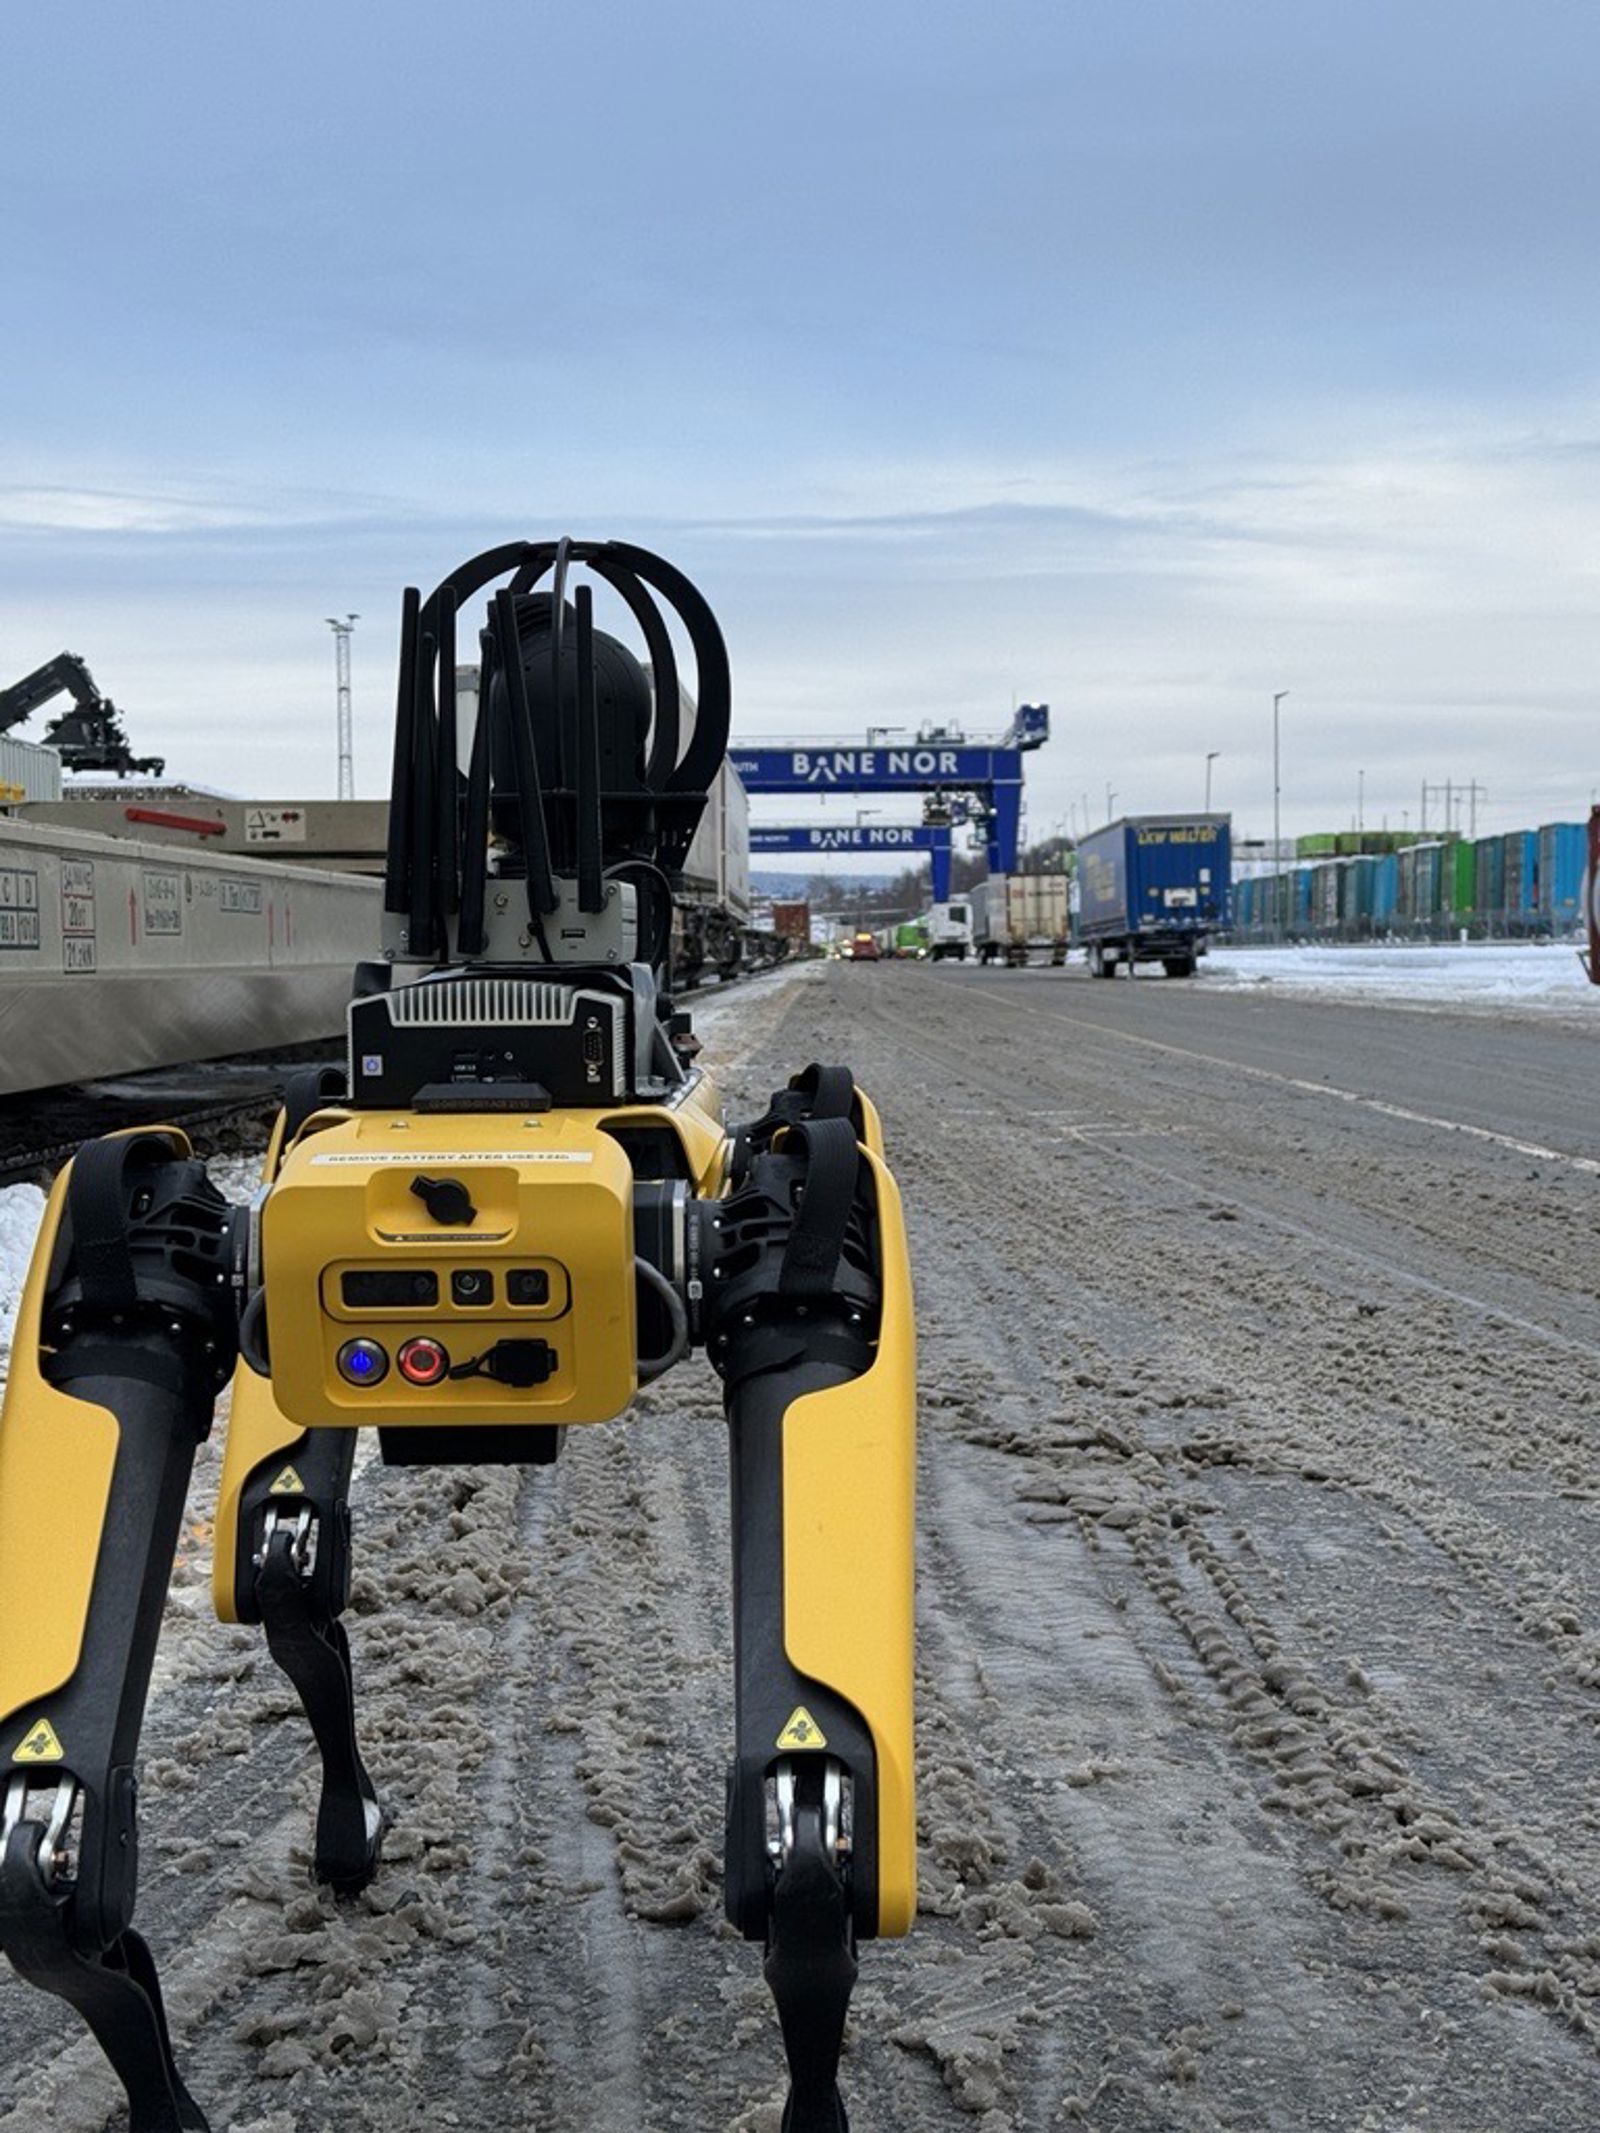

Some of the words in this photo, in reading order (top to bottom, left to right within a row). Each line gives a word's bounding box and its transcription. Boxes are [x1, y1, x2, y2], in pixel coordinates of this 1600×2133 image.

[792, 752, 876, 782] BANE
[889, 751, 958, 774] NOR
[810, 830, 863, 848] BANE
[869, 829, 914, 844] NOR
